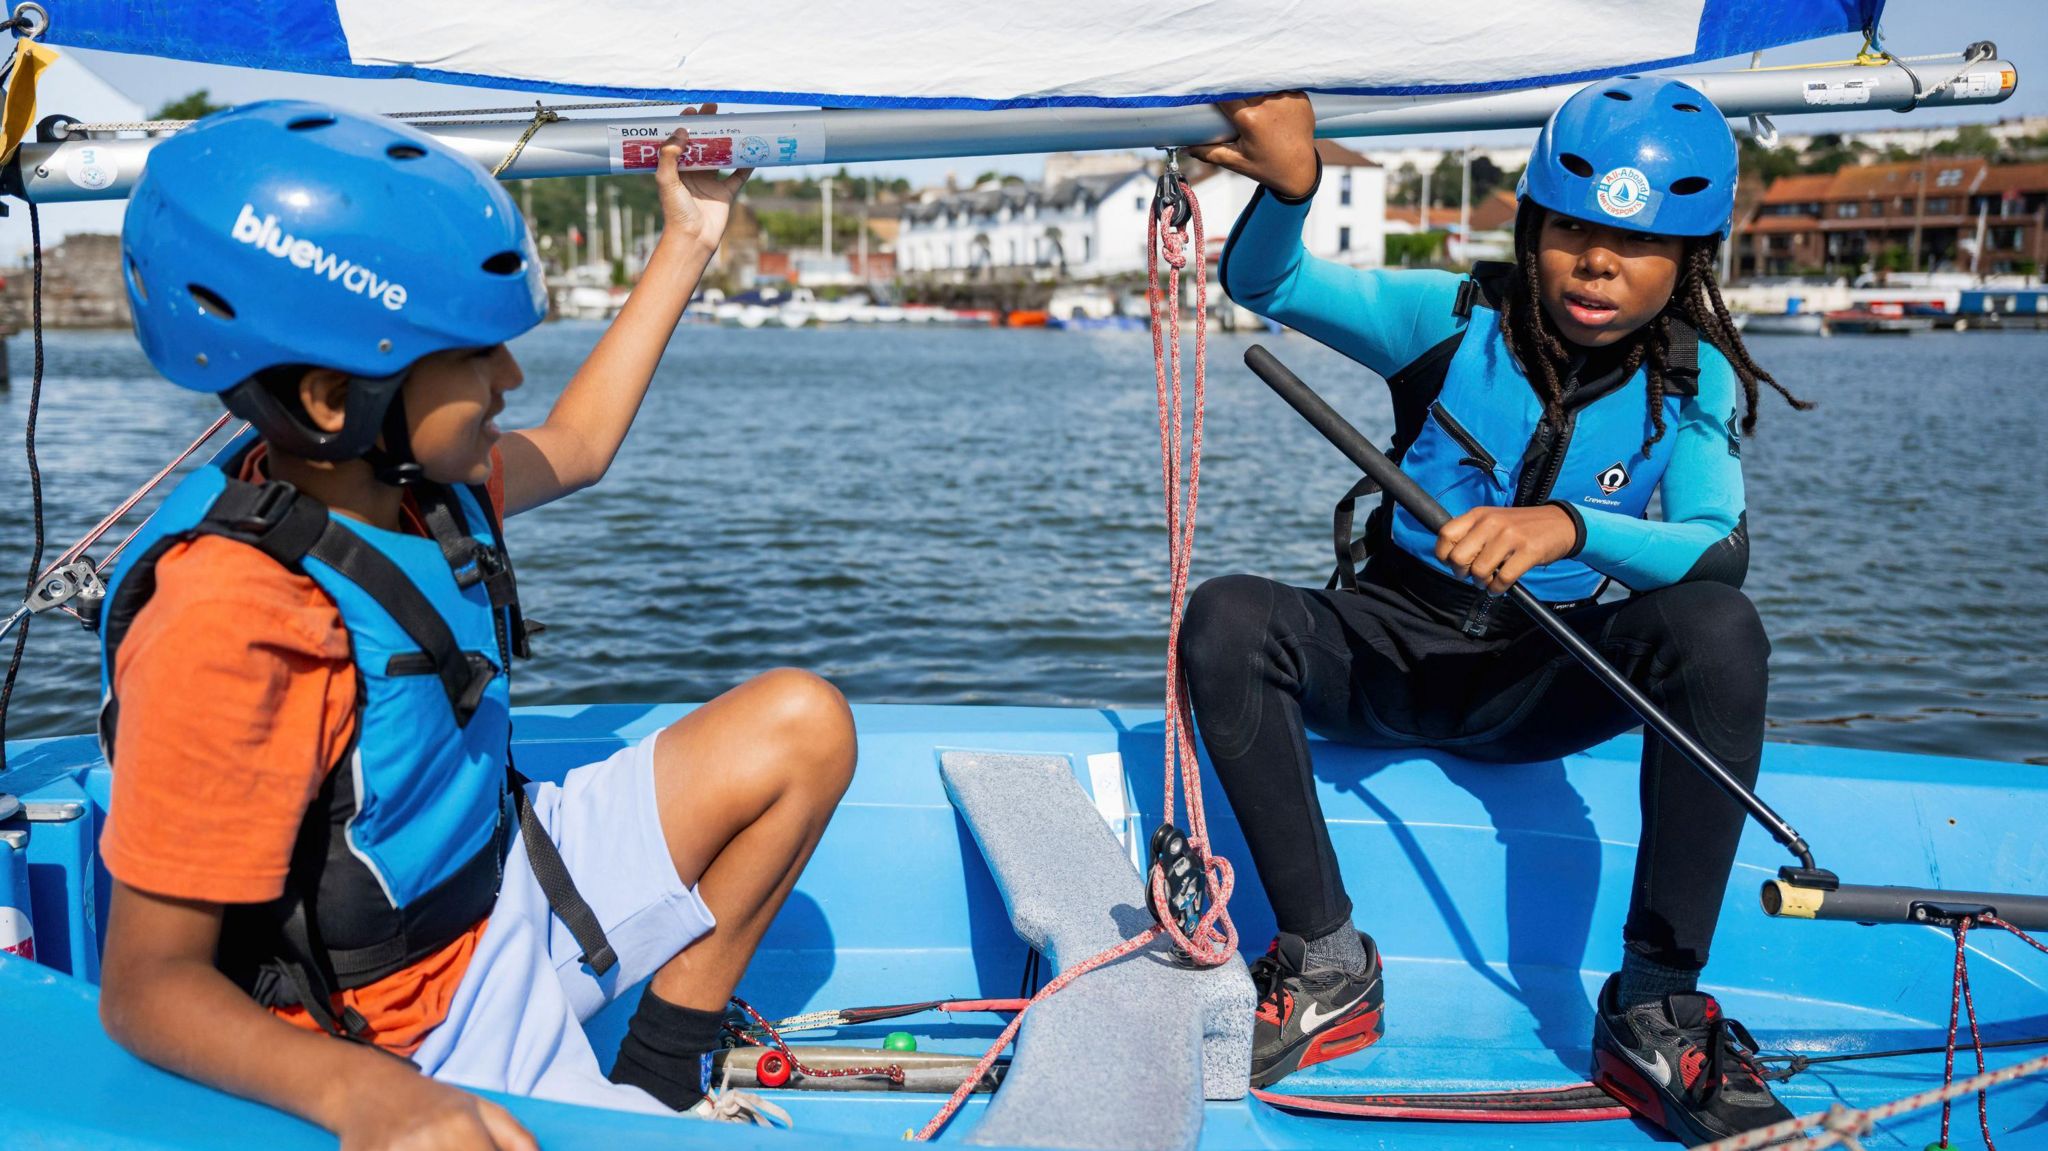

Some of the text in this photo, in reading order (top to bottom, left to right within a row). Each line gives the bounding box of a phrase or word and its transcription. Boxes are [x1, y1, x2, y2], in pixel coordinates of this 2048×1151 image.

[621, 128, 658, 137] BOOM
[640, 142, 709, 164] PRT
[1605, 168, 1648, 193] All-Aboard
[1599, 192, 1642, 215] WATERSPORTS
[231, 203, 408, 311] bluewave
[1583, 495, 1622, 506] Crewsaver
